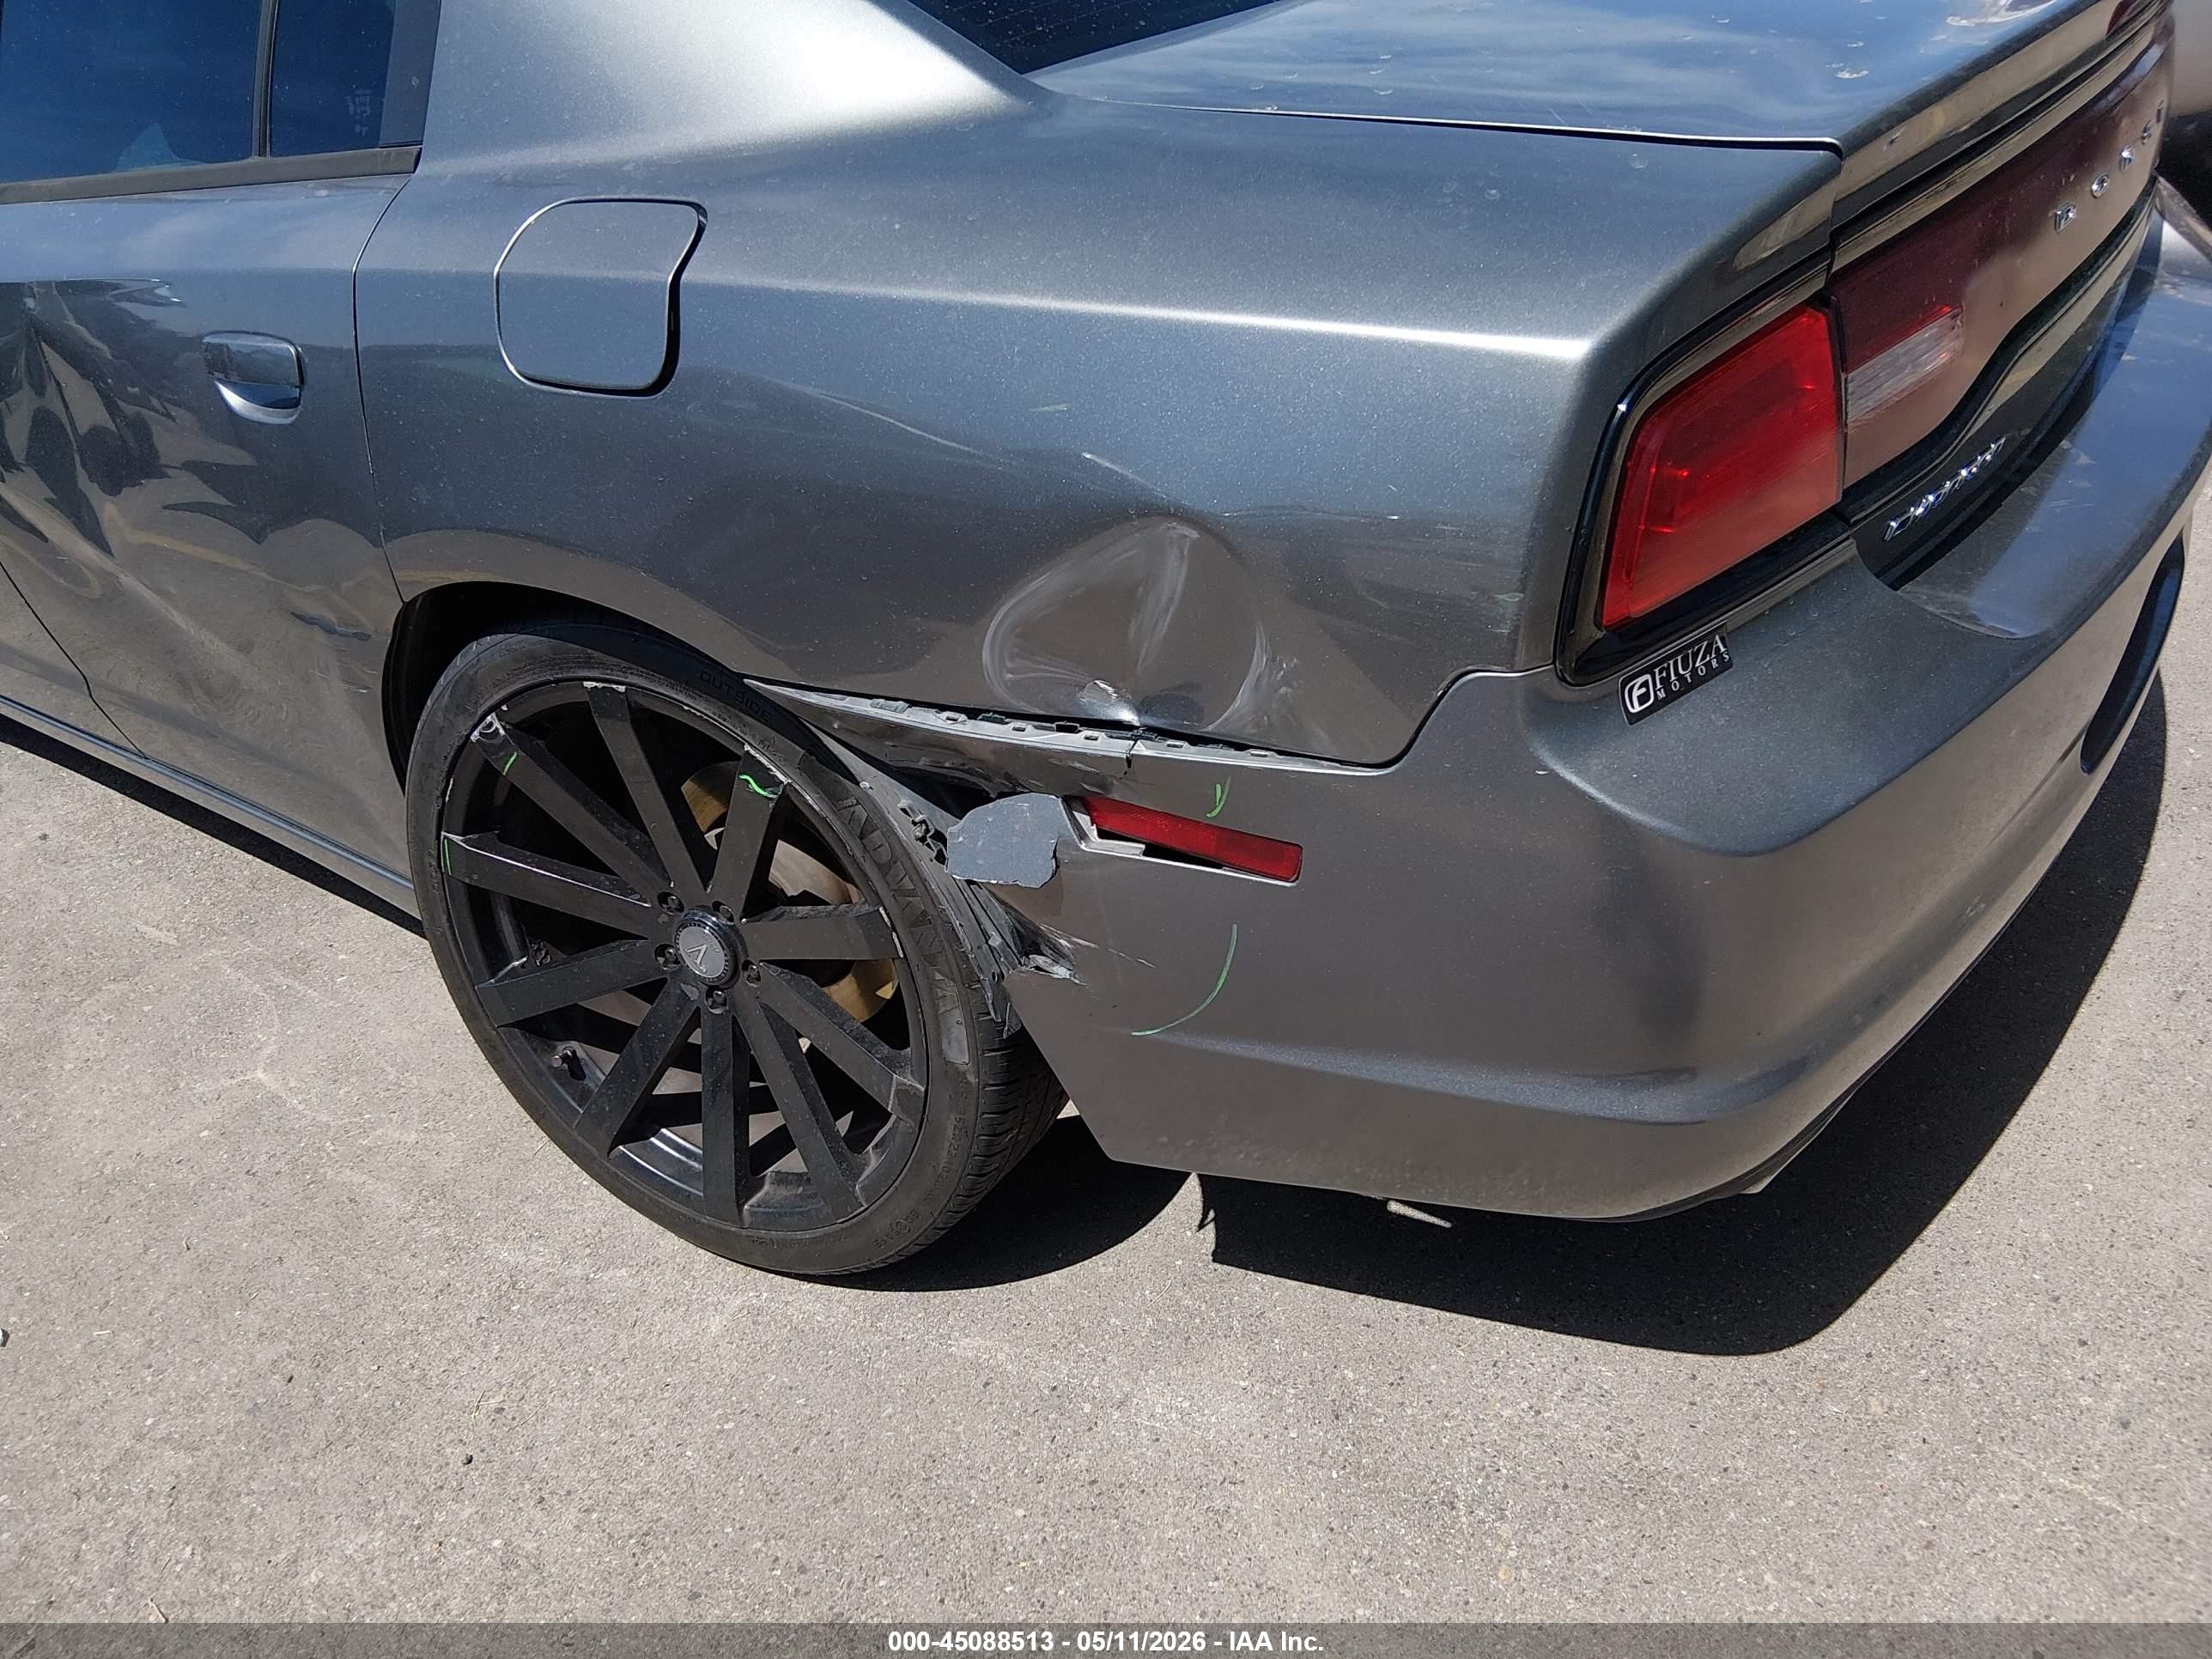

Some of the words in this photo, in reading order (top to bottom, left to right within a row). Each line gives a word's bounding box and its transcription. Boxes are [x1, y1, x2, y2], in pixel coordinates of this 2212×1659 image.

[2053, 99, 2166, 233] DOD
[1653, 634, 1728, 690] FIUZA
[1656, 651, 1730, 701] MOTORS
[700, 671, 771, 722] OUTSIDE
